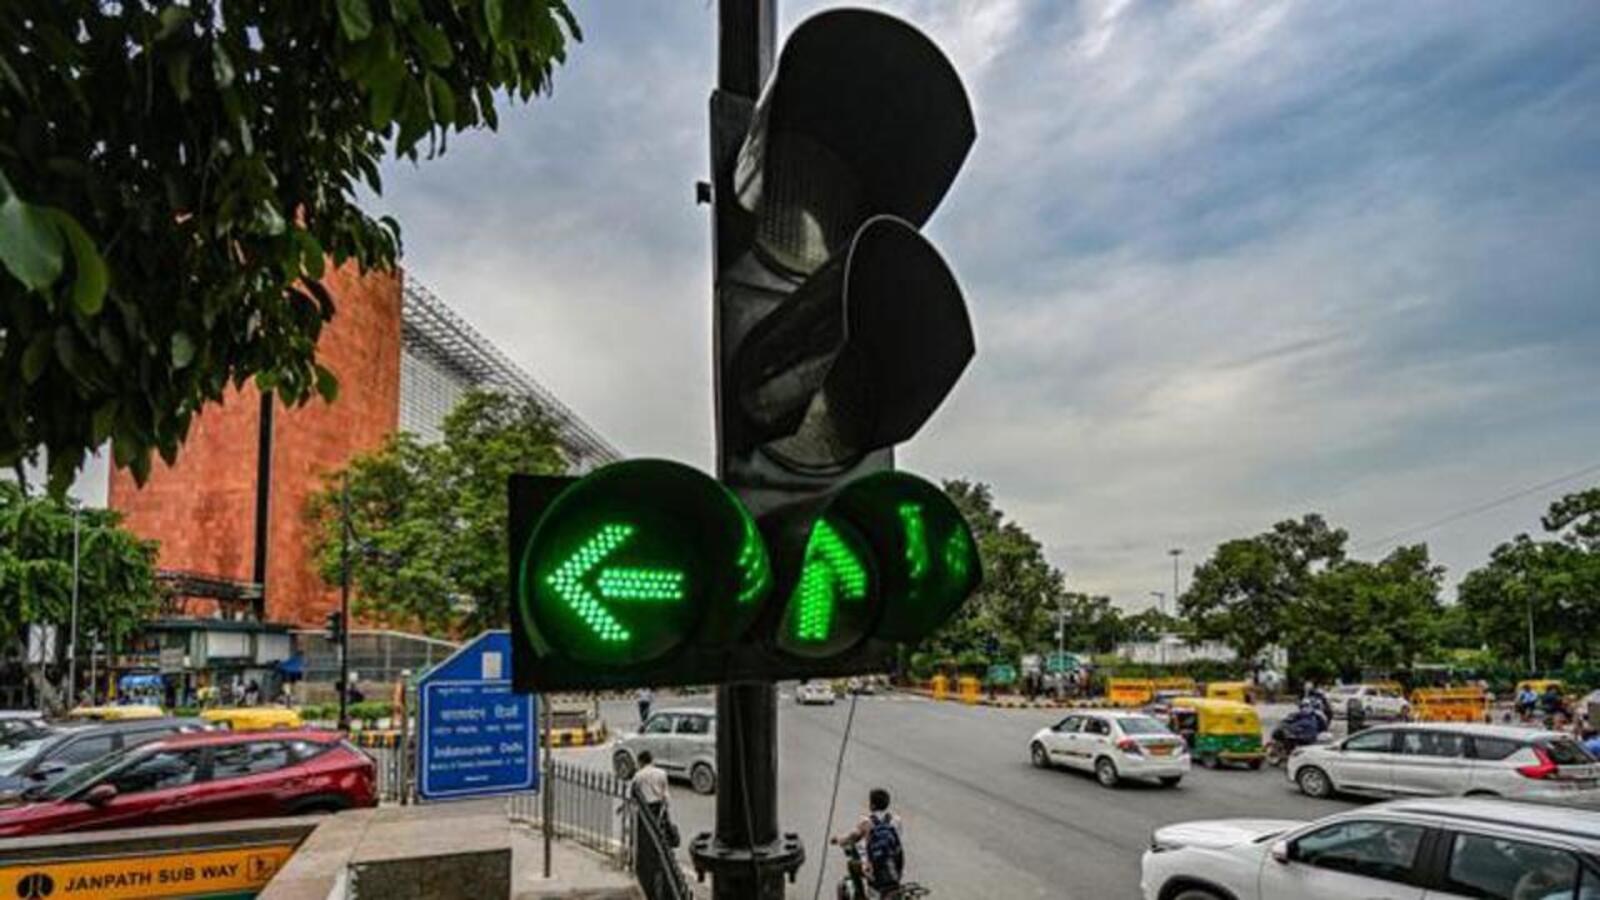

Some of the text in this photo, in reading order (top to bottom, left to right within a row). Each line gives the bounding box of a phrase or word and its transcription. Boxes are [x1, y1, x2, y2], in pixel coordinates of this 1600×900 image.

[65, 864, 240, 891] JANPATH SUB WAY
